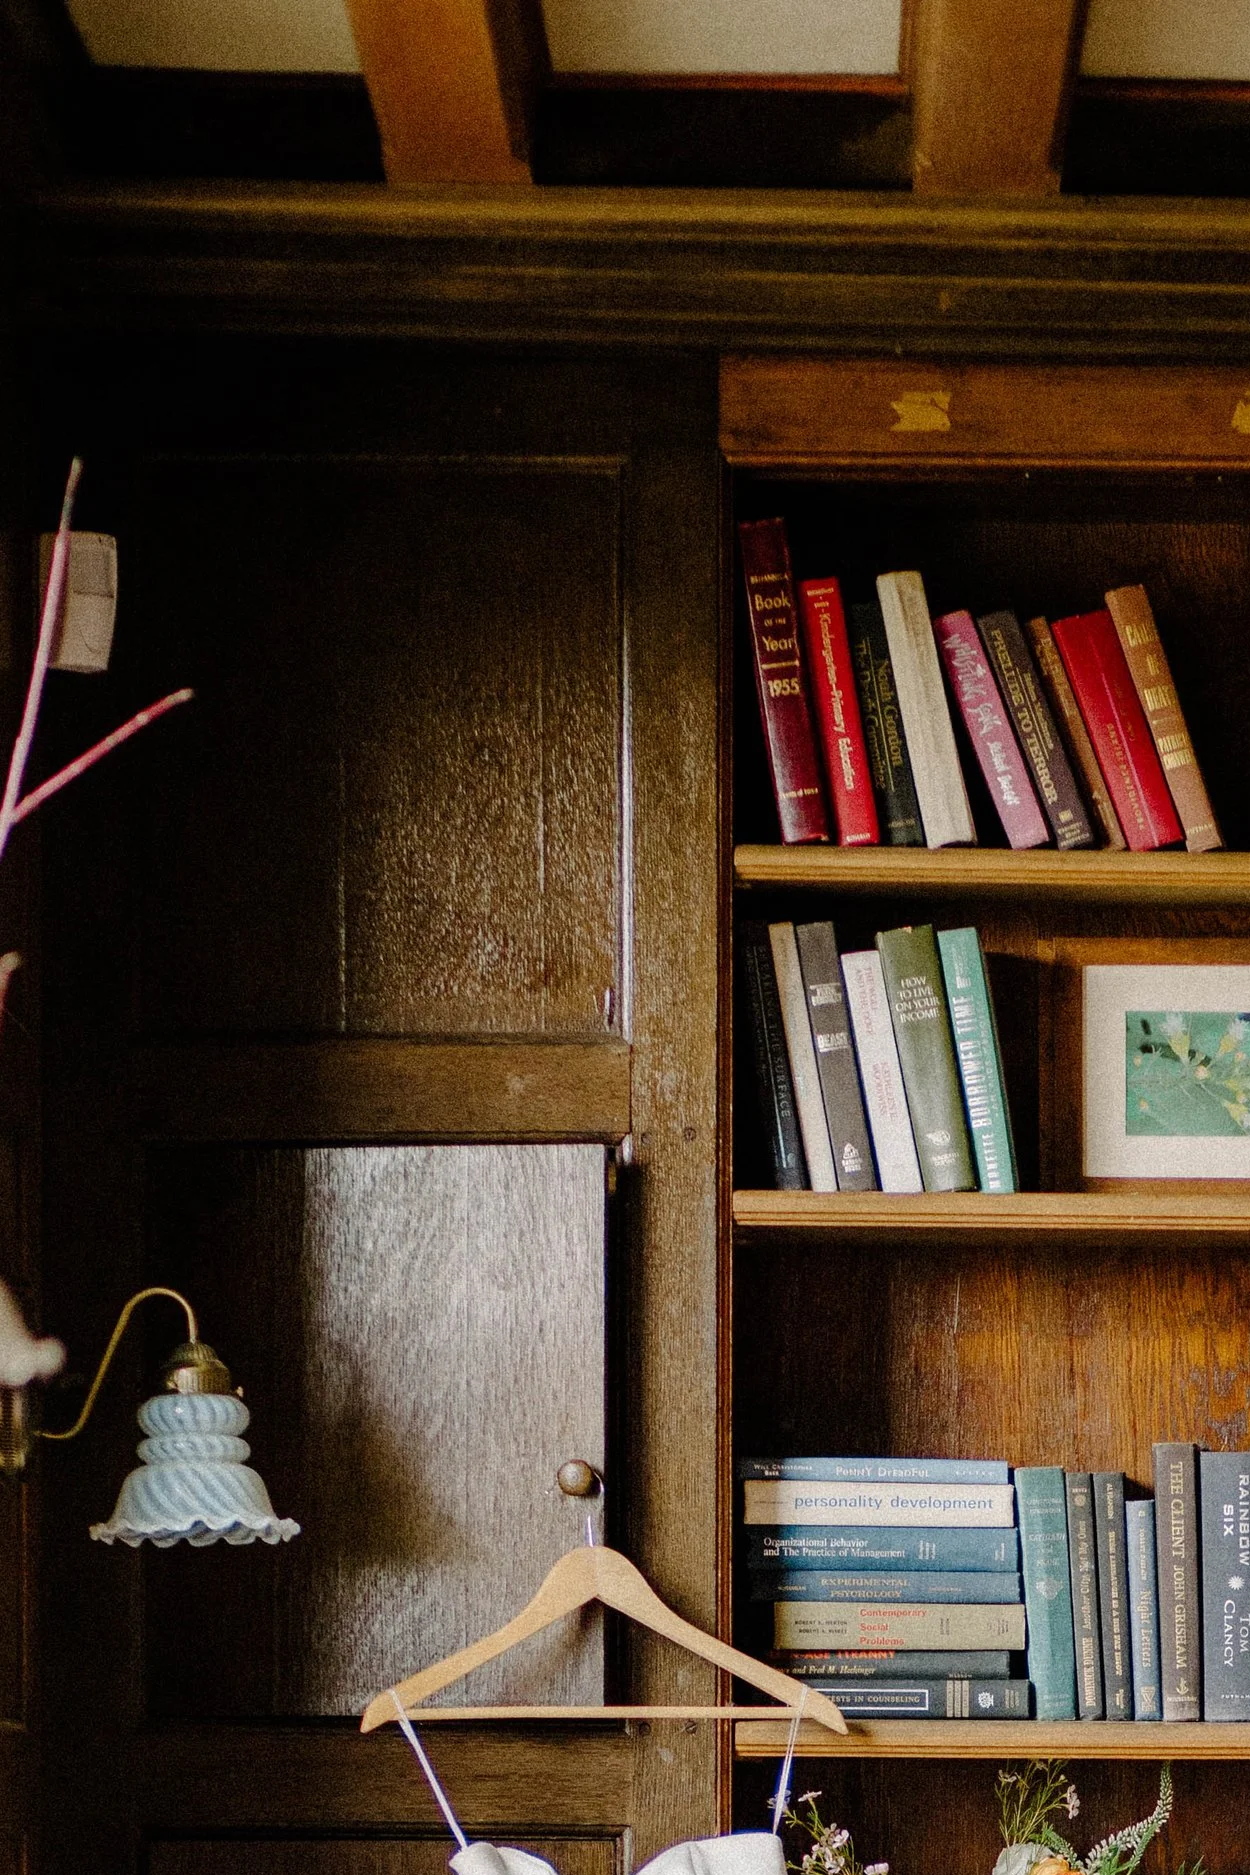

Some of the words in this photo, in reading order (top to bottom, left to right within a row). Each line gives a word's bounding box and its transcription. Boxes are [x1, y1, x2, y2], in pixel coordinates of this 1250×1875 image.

[754, 590, 791, 611] Book
[762, 636, 797, 652] Year
[767, 677, 799, 698] 1955
[877, 658, 894, 698] Noah
[991, 629, 1019, 706] PRELUDE
[1016, 706, 1034, 734] TO
[1026, 732, 1058, 806] TERROR
[882, 703, 905, 768] Gordon
[838, 737, 856, 791] Education
[897, 988, 914, 1000] TO
[914, 985, 933, 998] LIVE
[900, 976, 927, 989] HOW
[895, 1000, 912, 1013] ON
[912, 996, 941, 1011] YOUR
[899, 1008, 941, 1024] INCOME
[953, 995, 977, 1035] TIME
[773, 1056, 791, 1118] SURFACE
[960, 1040, 991, 1129] BORROWED
[980, 1132, 1000, 1189] MONETTE
[1170, 1461, 1183, 1494] THE
[794, 1495, 883, 1510] personality
[890, 1495, 993, 1512] development
[1171, 1499, 1186, 1559] CLIENT
[1222, 1503, 1235, 1537] SIX
[1238, 1474, 1250, 1566] RAINBOW
[763, 1537, 828, 1549] Organizational
[830, 1537, 869, 1549] Behavior
[763, 1547, 780, 1557] and
[782, 1547, 800, 1557] The
[802, 1547, 836, 1558] Practice
[838, 1547, 849, 1558] of
[850, 1547, 905, 1560] Management
[821, 1578, 912, 1588] EXPERIMENTAL
[830, 1589, 903, 1599] PSYCHOLOGY
[1173, 1565, 1186, 1599] JOHN
[860, 1608, 927, 1619] Contemporary
[1081, 1595, 1092, 1630] Another
[1137, 1590, 1153, 1625] Night
[859, 1622, 889, 1632] Social
[859, 1636, 905, 1646] Problems
[1174, 1603, 1188, 1669] GRISHAM
[1222, 1599, 1236, 1668] CLANCY
[836, 1650, 896, 1661] TYRANNY
[1082, 1636, 1095, 1664] DUNNE
[1141, 1628, 1153, 1668] Letters
[793, 1665, 806, 1675] and
[809, 1665, 826, 1675] Fred
[827, 1665, 838, 1675] M.
[840, 1665, 876, 1677] Hechinger
[1084, 1664, 1097, 1707] DOMINICK
[855, 1695, 864, 1704] IN
[867, 1695, 921, 1704] COUNSELING
